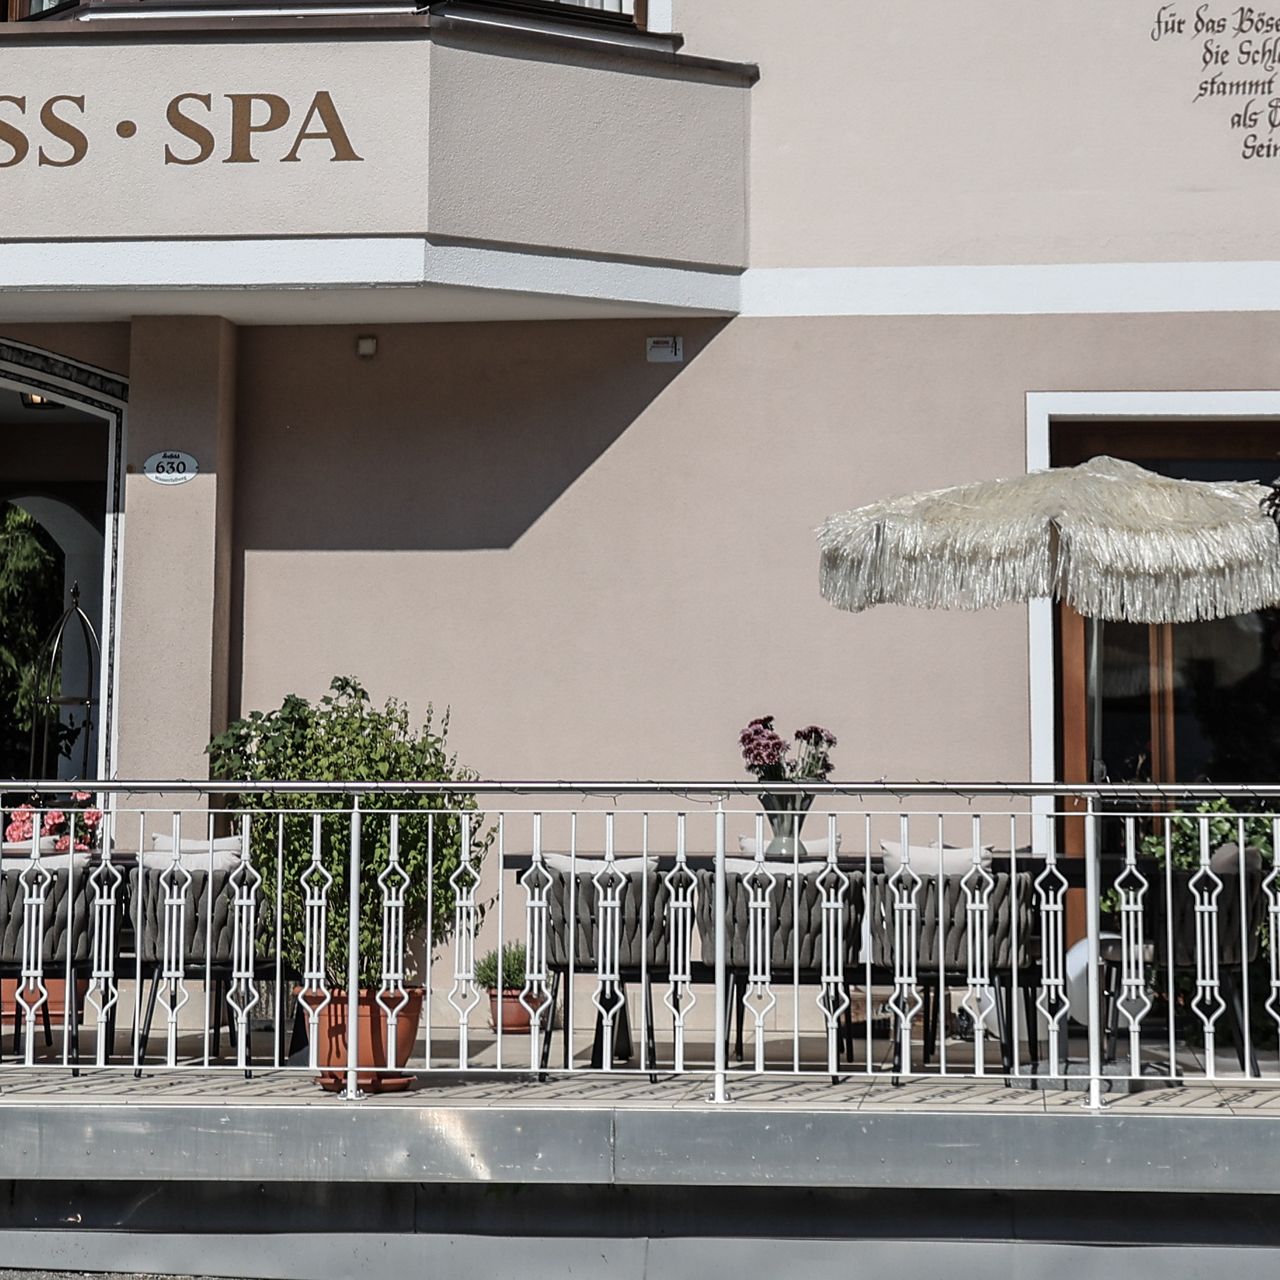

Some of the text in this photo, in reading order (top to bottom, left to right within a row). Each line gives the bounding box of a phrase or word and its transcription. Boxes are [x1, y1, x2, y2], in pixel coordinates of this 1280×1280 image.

[1192, 4, 1226, 39] das
[1202, 39, 1229, 72] die
[1193, 72, 1278, 102] stammt
[165, 91, 365, 166] SPA
[1231, 99, 1263, 129] als
[156, 461, 186, 474] 630
